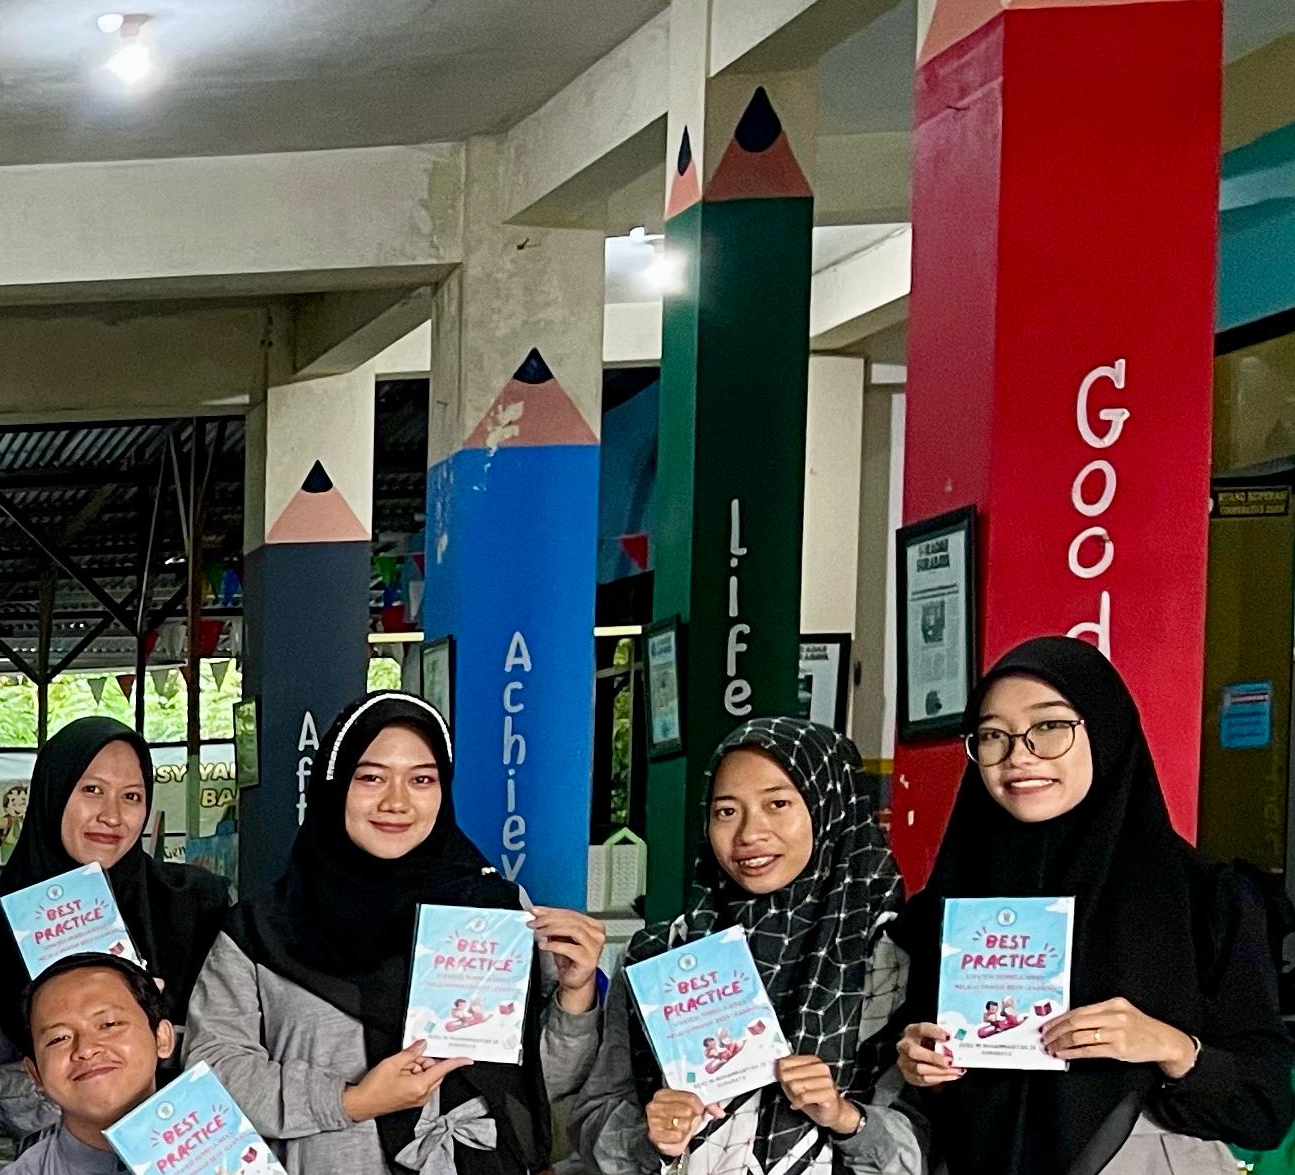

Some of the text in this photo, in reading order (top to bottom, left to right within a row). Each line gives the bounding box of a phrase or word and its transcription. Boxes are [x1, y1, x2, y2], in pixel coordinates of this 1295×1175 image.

[1065, 358, 1130, 662] Good
[724, 498, 753, 716] Life
[34, 907, 104, 945] PRACTICE
[46, 899, 82, 921] BEST
[457, 938, 499, 954] BEST
[985, 934, 1030, 949] BEST
[961, 953, 1047, 970] PRACTICE
[677, 971, 718, 994] BEST
[663, 981, 744, 1020] PRACTICE
[156, 1115, 227, 1174] PRACTICE
[162, 1111, 201, 1145] BEST
